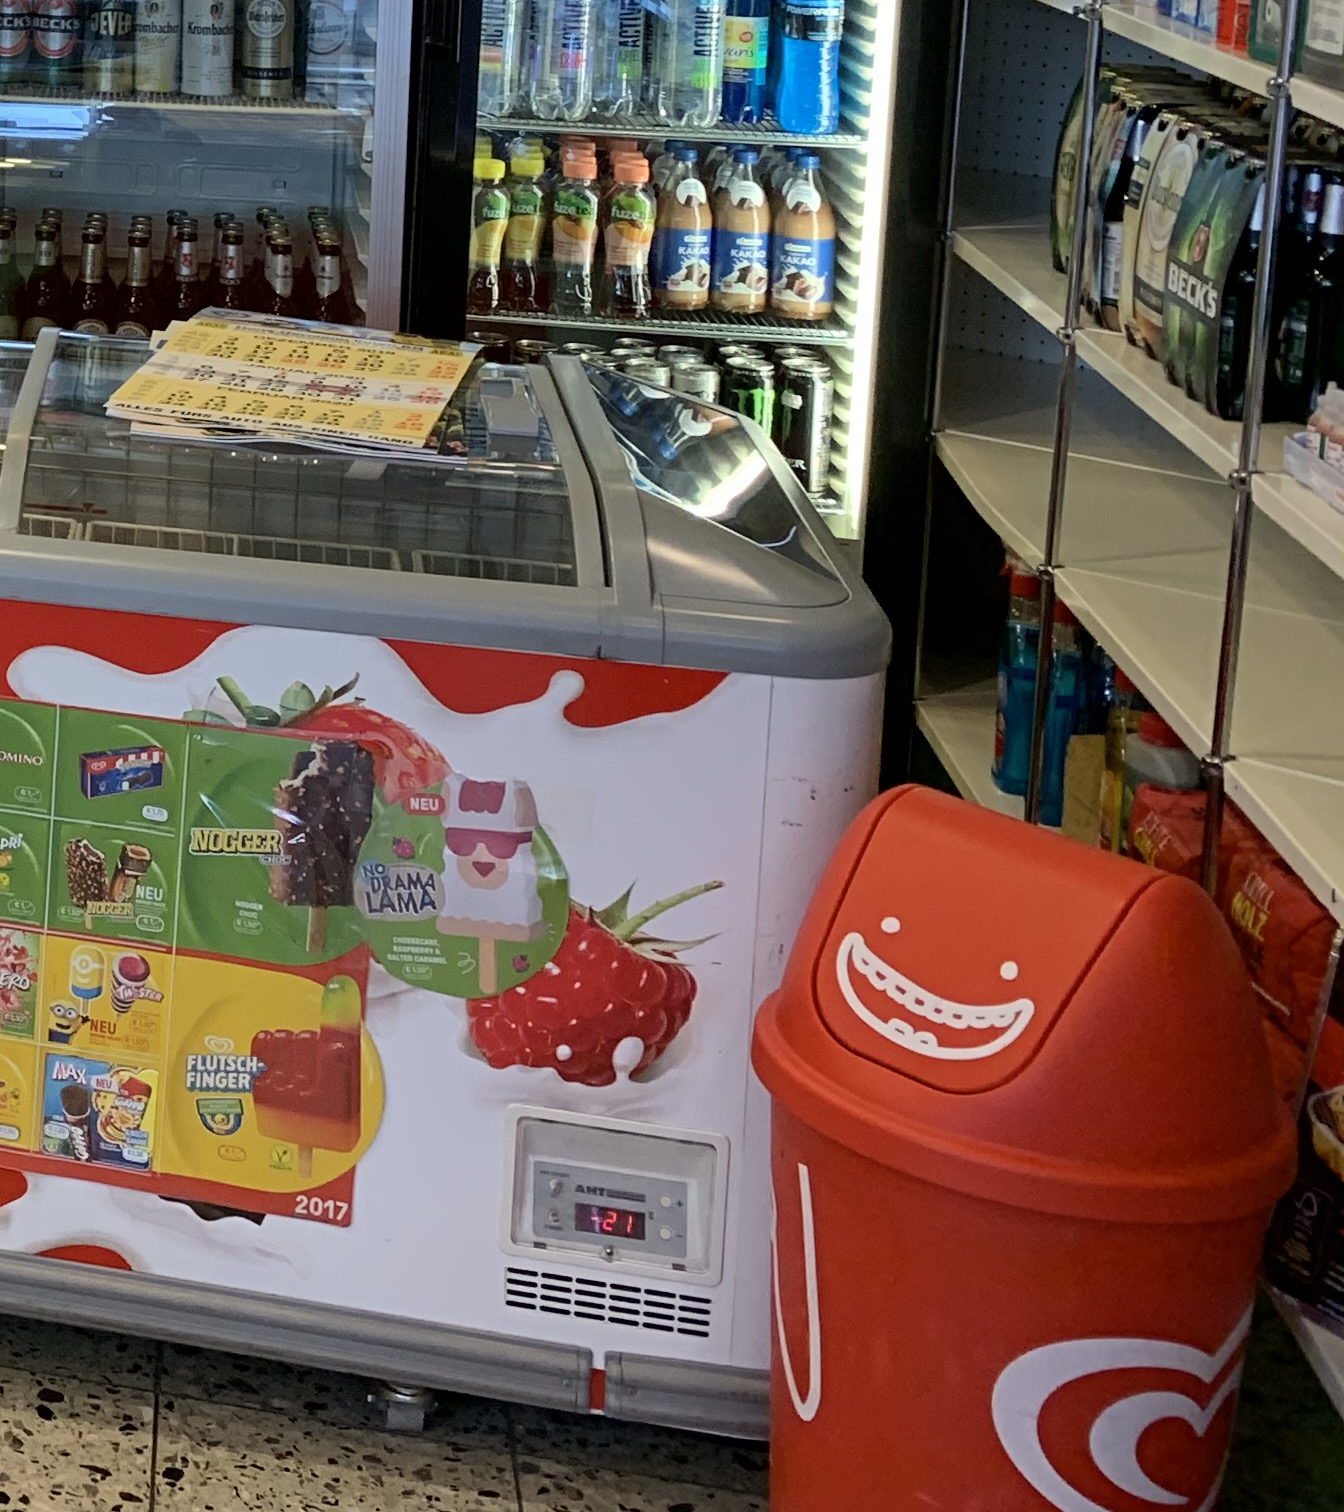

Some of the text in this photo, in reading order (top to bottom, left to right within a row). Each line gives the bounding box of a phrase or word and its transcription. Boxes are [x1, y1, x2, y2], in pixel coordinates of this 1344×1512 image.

[730, 248, 767, 259] KAKAO
[779, 255, 816, 266] KAKAO
[1169, 263, 1217, 319] BECK'S
[114, 401, 163, 414] ALLES
[219, 414, 264, 425] AUTO
[409, 797, 439, 811] NEU
[191, 828, 282, 855] NOGGER
[362, 863, 386, 877] NO
[370, 870, 437, 893] DRAMA
[135, 884, 163, 901] NEU
[364, 890, 438, 914] LAMA
[90, 1019, 117, 1035] NEU
[52, 1061, 88, 1085] MAX
[186, 1054, 266, 1075] FLUTSCH-
[96, 1077, 112, 1090] NEU
[186, 1071, 254, 1090] FINGER
[294, 1195, 350, 1223] 2017
